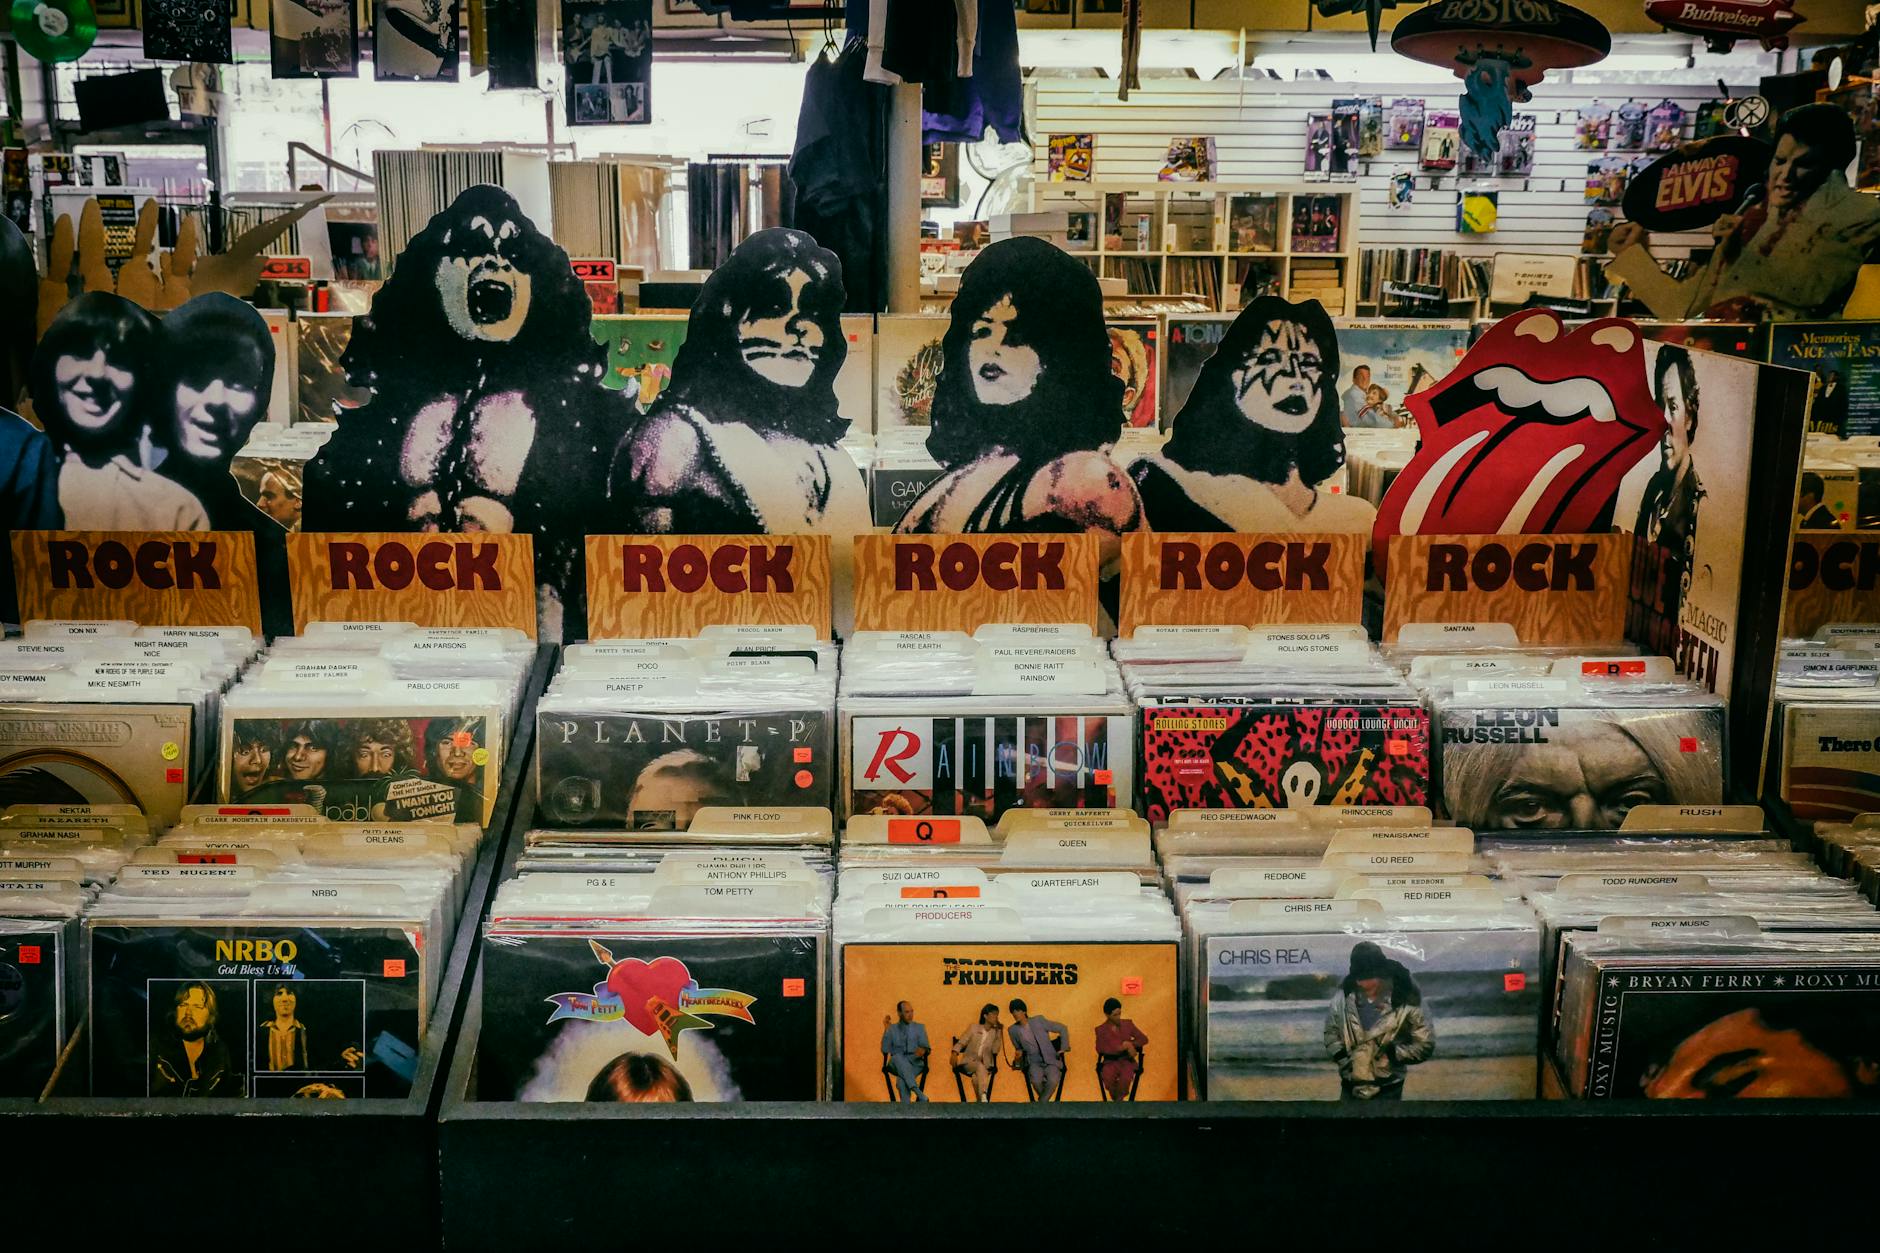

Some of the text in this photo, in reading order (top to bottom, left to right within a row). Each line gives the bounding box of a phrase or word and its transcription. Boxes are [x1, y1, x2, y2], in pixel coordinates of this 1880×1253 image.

[1442, 0, 1553, 24] BOSTON
[1680, 2, 1765, 27] Budweiser
[1667, 154, 1728, 177] ALWAYS
[1655, 166, 1732, 208] ELVIS
[48, 540, 222, 590] ROCK
[328, 542, 502, 591] ROCK
[622, 544, 794, 594] ROCK
[894, 542, 1066, 592] ROCK
[1160, 541, 1331, 591] ROCK
[1425, 543, 1599, 592] ROCK
[1686, 602, 1727, 644] MAGIC
[1012, 626, 1059, 634] RASPBERRIES
[1013, 648, 1076, 656] REVERE/RAIDERS
[88, 680, 106, 688] MIKE
[1475, 707, 1559, 727] LEON
[1155, 719, 1225, 729] ROLLING STONES
[1327, 718, 1418, 729] VOODOO LOUNGE UNCUT
[562, 719, 757, 744] PLANET
[1441, 727, 1549, 744] RUSSELL
[1818, 736, 1872, 752] There
[863, 726, 1108, 784] RAINBOW
[401, 795, 432, 809] WANT
[433, 791, 454, 802] YOU
[410, 802, 455, 819] TONIGHT
[1341, 808, 1393, 817] RHINOCEROS
[1680, 808, 1722, 816] RUSH
[733, 813, 781, 821] PINK FLOYD
[1200, 813, 1277, 821] REO SPEEDWAGON
[20, 831, 80, 839] GRAHAM NASH
[916, 821, 933, 841] Q
[366, 836, 404, 844] ORLEANS
[15, 861, 52, 869] MURPHY
[1370, 856, 1414, 864] LOU REED
[707, 871, 787, 879] ANTHONY PHILLIPS
[882, 871, 940, 881] SUZI QUATRO
[1264, 872, 1306, 881] REDBONE
[1601, 876, 1678, 886] TODD RUNDGREN
[586, 878, 616, 888] PG & E
[1030, 878, 1099, 888] QUARTERFLASH
[311, 889, 338, 897] NRBQ
[704, 887, 754, 896] TOM PETTY
[1404, 891, 1451, 900] RED RIDER
[1284, 903, 1333, 913] CHRIS REA
[915, 911, 973, 920] PRODUCERS
[1651, 920, 1710, 928] ROXY MUSIC
[215, 940, 298, 962] NRBQ
[1219, 949, 1311, 965] CHRIS REA
[218, 963, 298, 976] God Bless Us All
[943, 957, 1078, 985] PRODUCERS
[1628, 975, 1694, 988] BRYAN
[1702, 975, 1767, 988] FERRY
[1794, 974, 1848, 987] ROXY
[1599, 995, 1618, 1055] MUSIC
